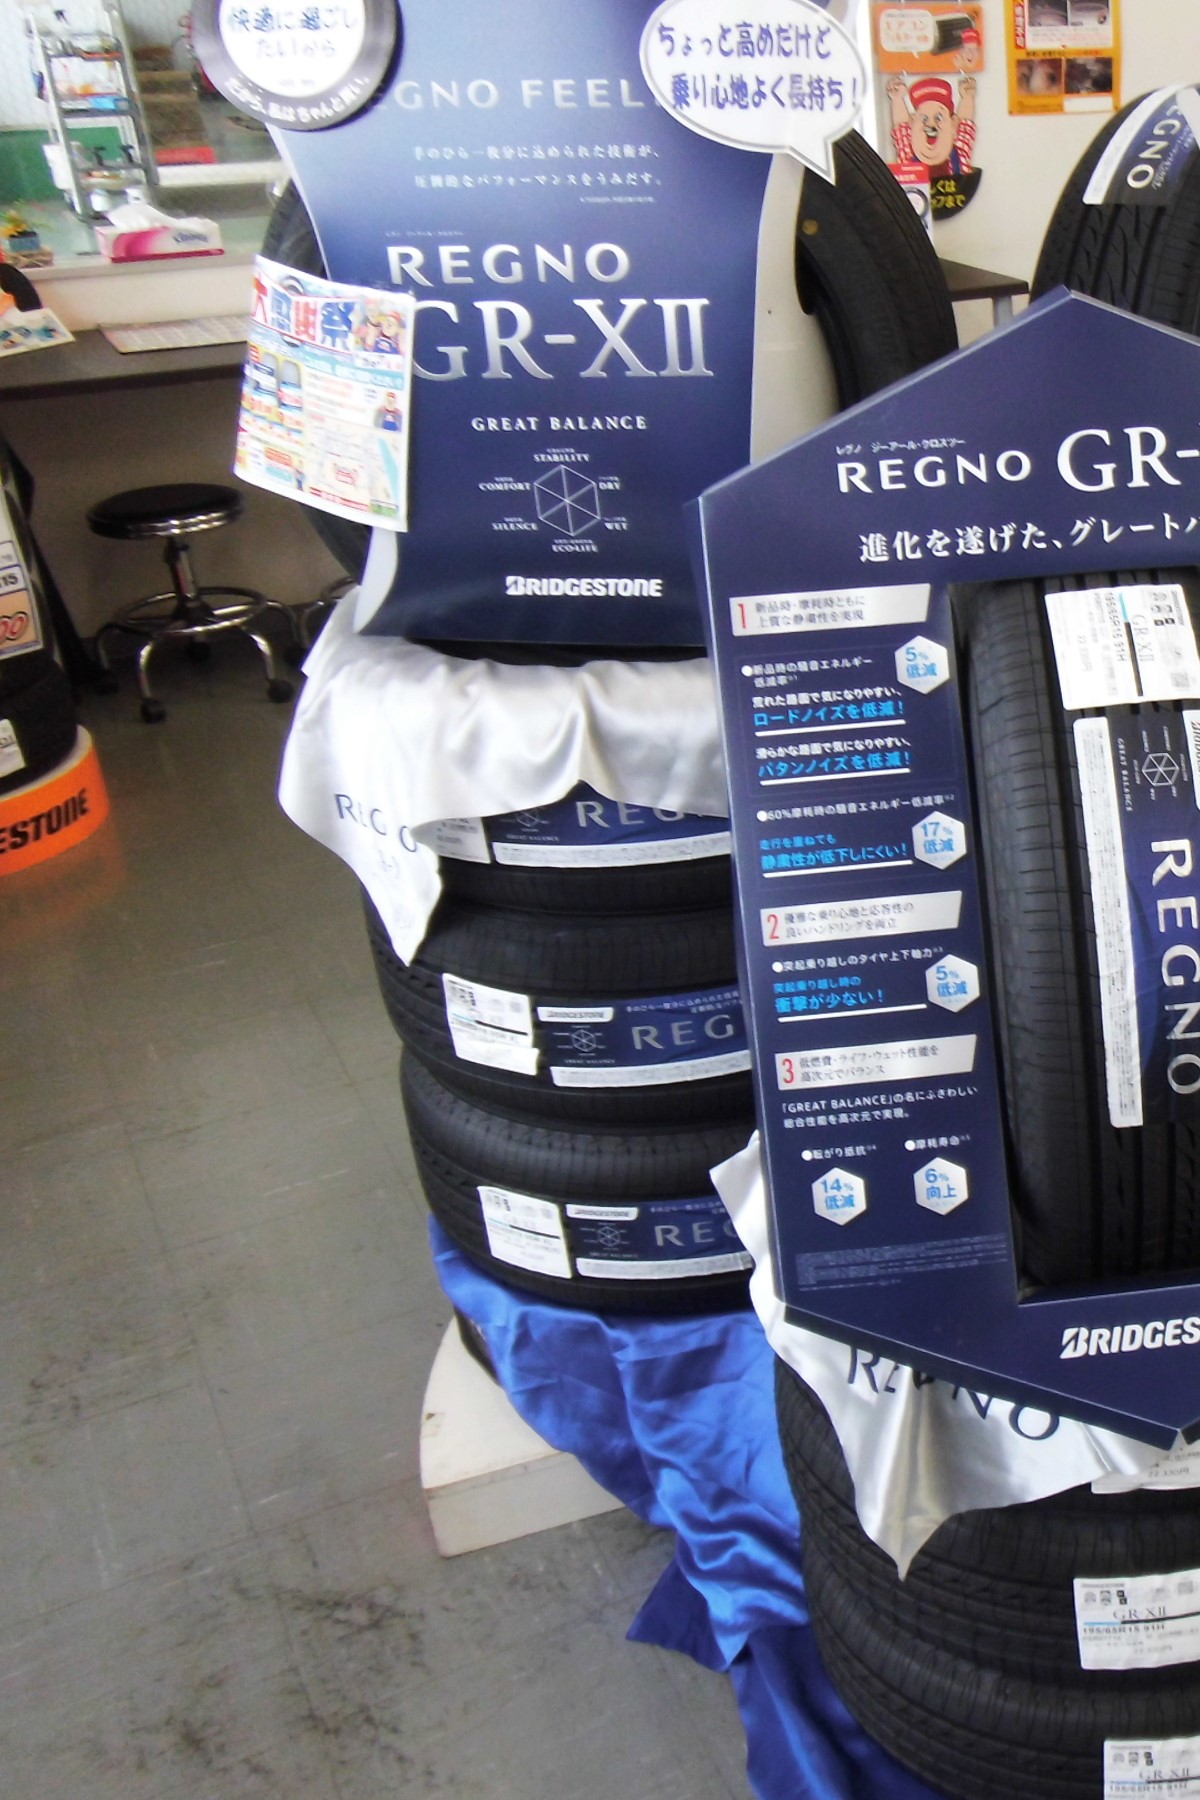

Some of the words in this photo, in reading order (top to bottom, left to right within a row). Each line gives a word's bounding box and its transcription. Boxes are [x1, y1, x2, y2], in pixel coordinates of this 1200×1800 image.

[657, 21, 832, 61] ちょっと高めだけど
[380, 79, 499, 110] GNO
[670, 72, 859, 111] 乗り心地よく長持ち！
[385, 242, 630, 287] REGNO
[471, 416, 539, 432] GREAT
[549, 414, 649, 431] BALANCE
[533, 453, 590, 463] STABILITY
[836, 449, 1032, 494] REGNO
[478, 481, 532, 492] COMFORT
[491, 521, 539, 532] SILENCE
[504, 575, 663, 597] BRIDGESTONE
[738, 602, 748, 630] 1
[906, 662, 938, 679] 低減
[753, 700, 905, 728] ロードノイズを低減！
[757, 750, 911, 779] パタンノイズを低減！
[921, 837, 955, 855] 低減
[766, 913, 780, 941] 2
[936, 980, 969, 998] 低減
[782, 1058, 795, 1084] 3
[824, 1193, 856, 1211] 低減
[925, 1183, 958, 1201] 向上
